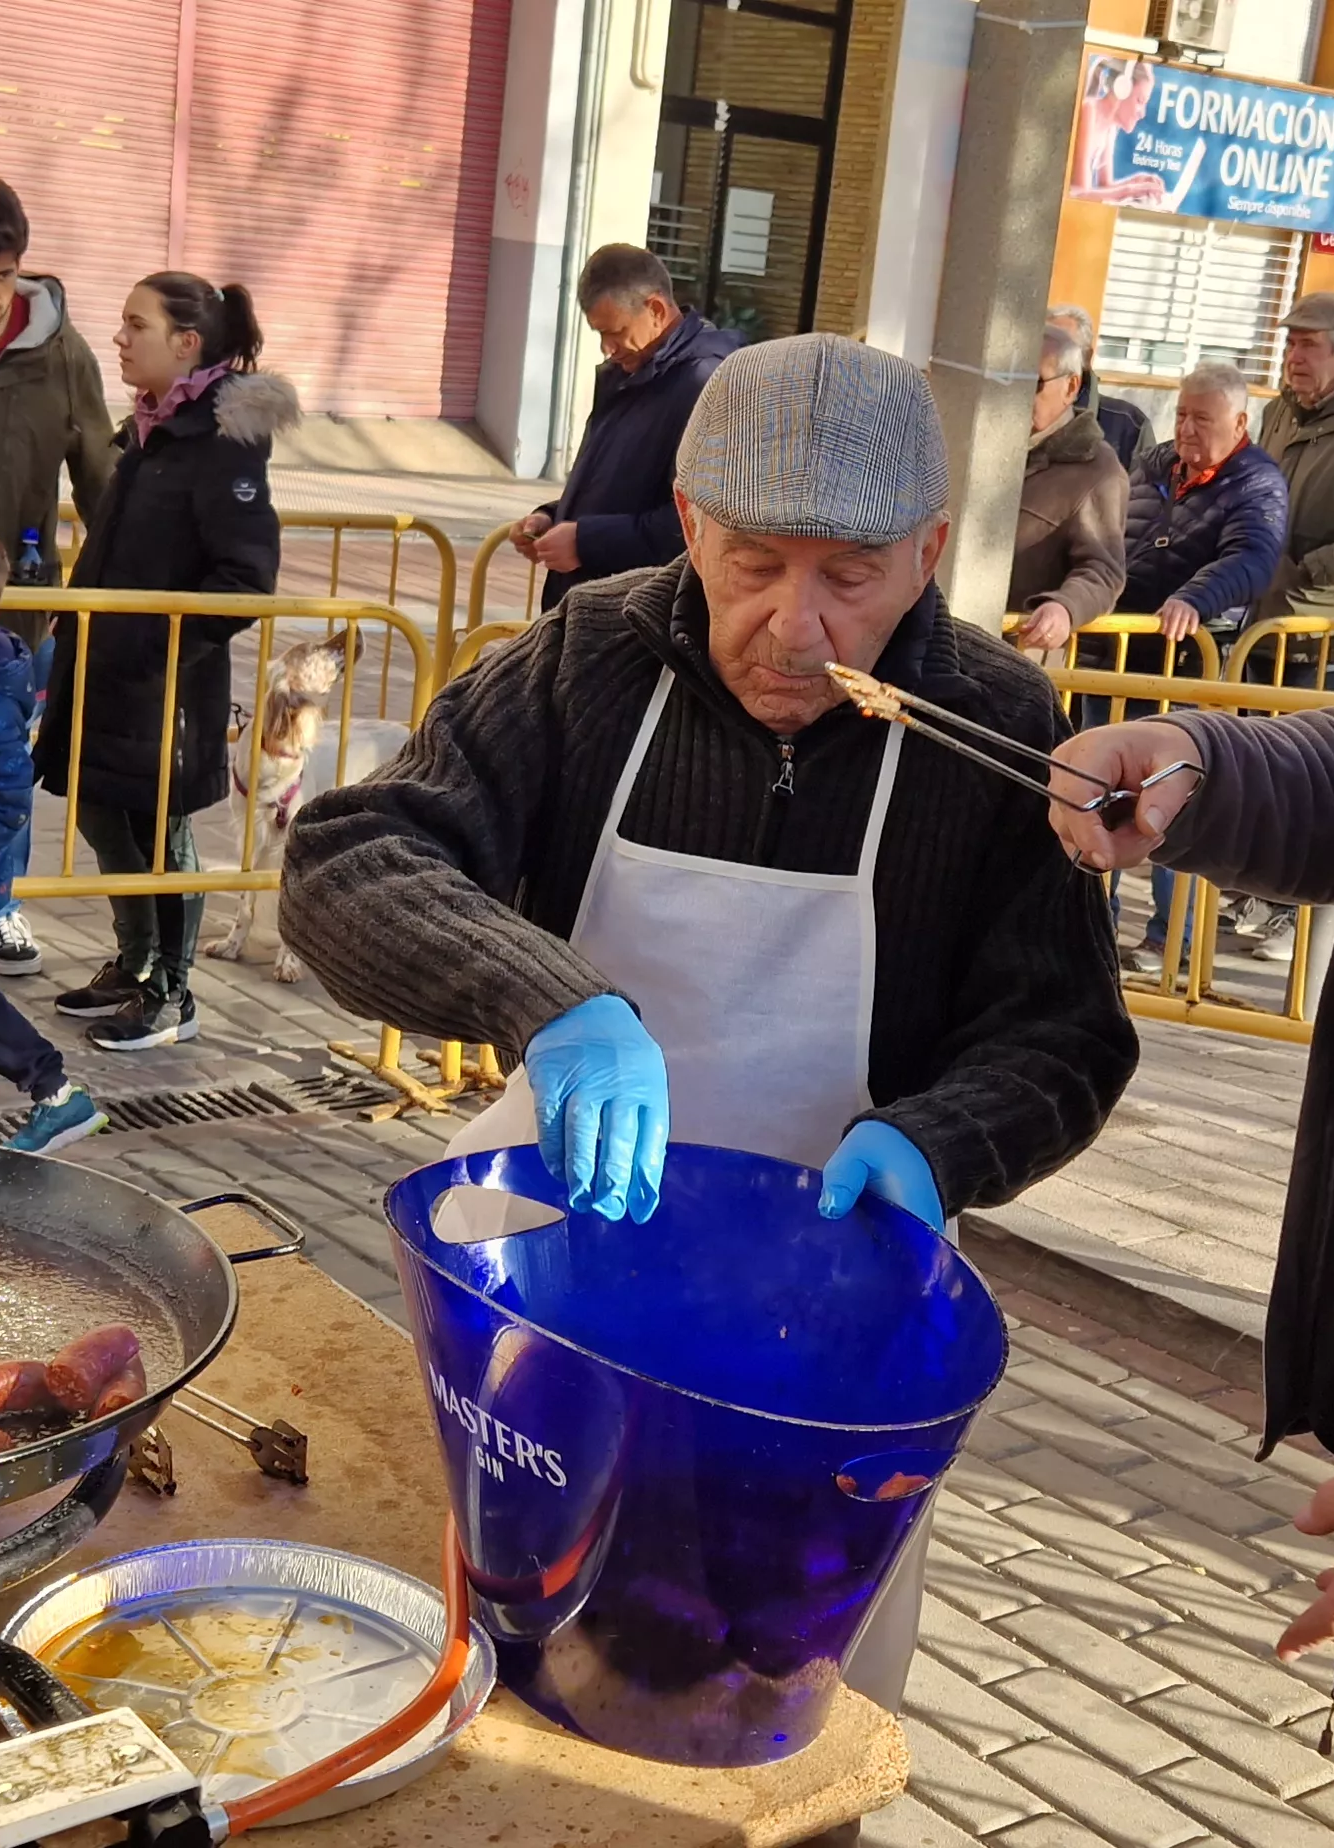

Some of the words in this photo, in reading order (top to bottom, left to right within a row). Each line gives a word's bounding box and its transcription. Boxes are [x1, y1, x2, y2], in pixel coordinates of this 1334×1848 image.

[1135, 132, 1153, 152] 24
[1155, 139, 1183, 158] Horas
[1220, 144, 1333, 199] ONLINE
[1227, 195, 1264, 215] Siempre
[1264, 200, 1312, 219] disponible
[428, 1360, 567, 1488] MASTER'S
[475, 1445, 504, 1482] GIN
